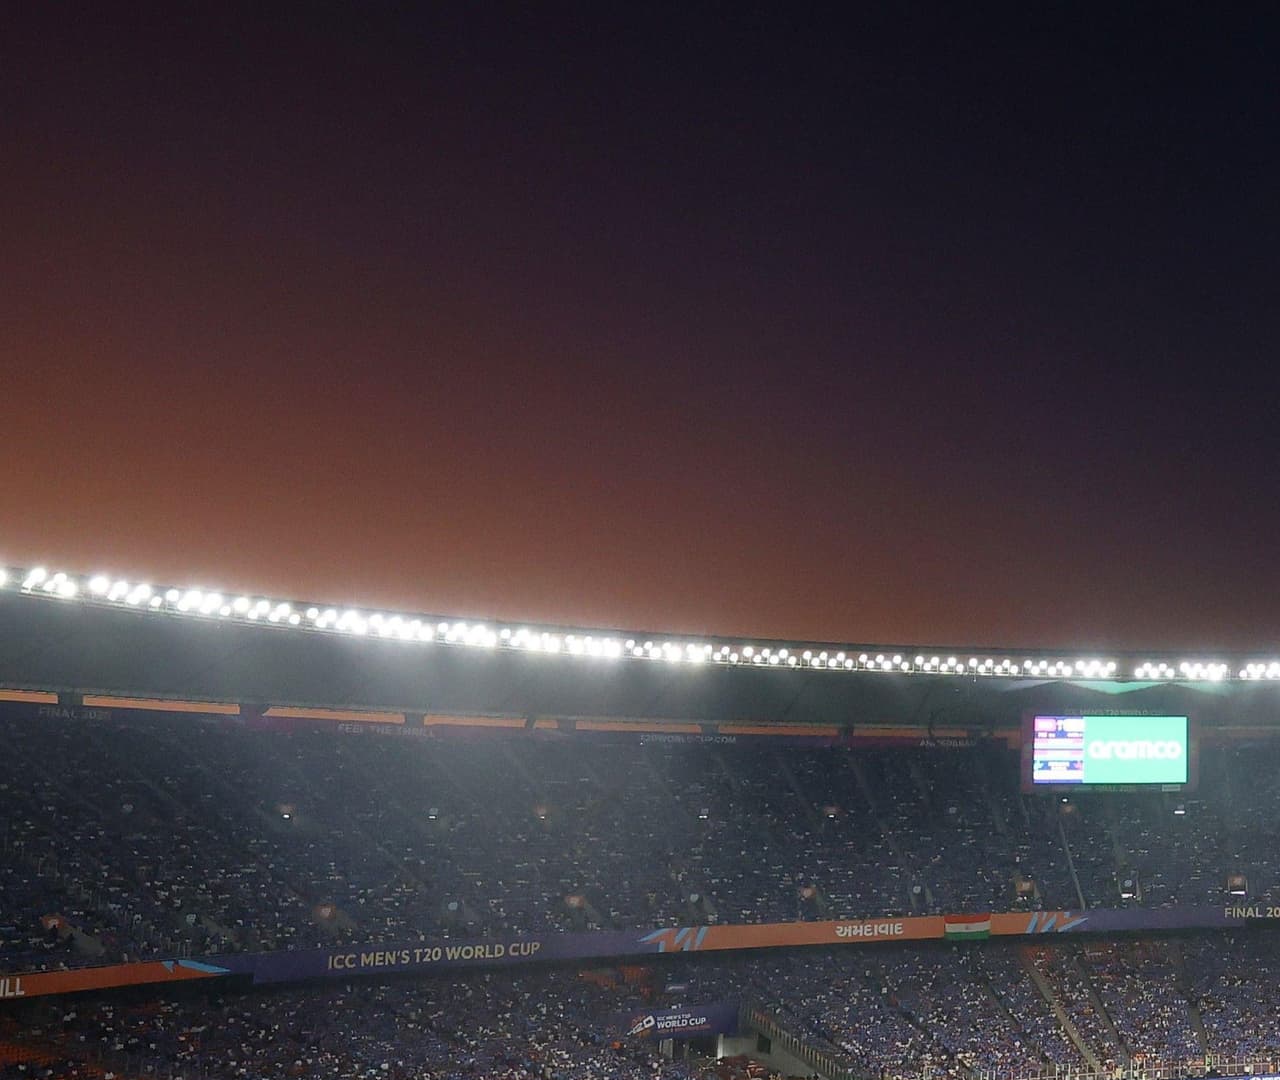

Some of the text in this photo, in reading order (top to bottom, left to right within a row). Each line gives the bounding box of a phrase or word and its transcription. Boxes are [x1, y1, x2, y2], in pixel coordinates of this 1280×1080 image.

[1088, 741, 1183, 760] aramco
[1224, 906, 1264, 919] FINAL
[328, 941, 541, 970] ICC MEN'S T20 WORLD CUP
[657, 1016, 706, 1029] WORLD CUP
